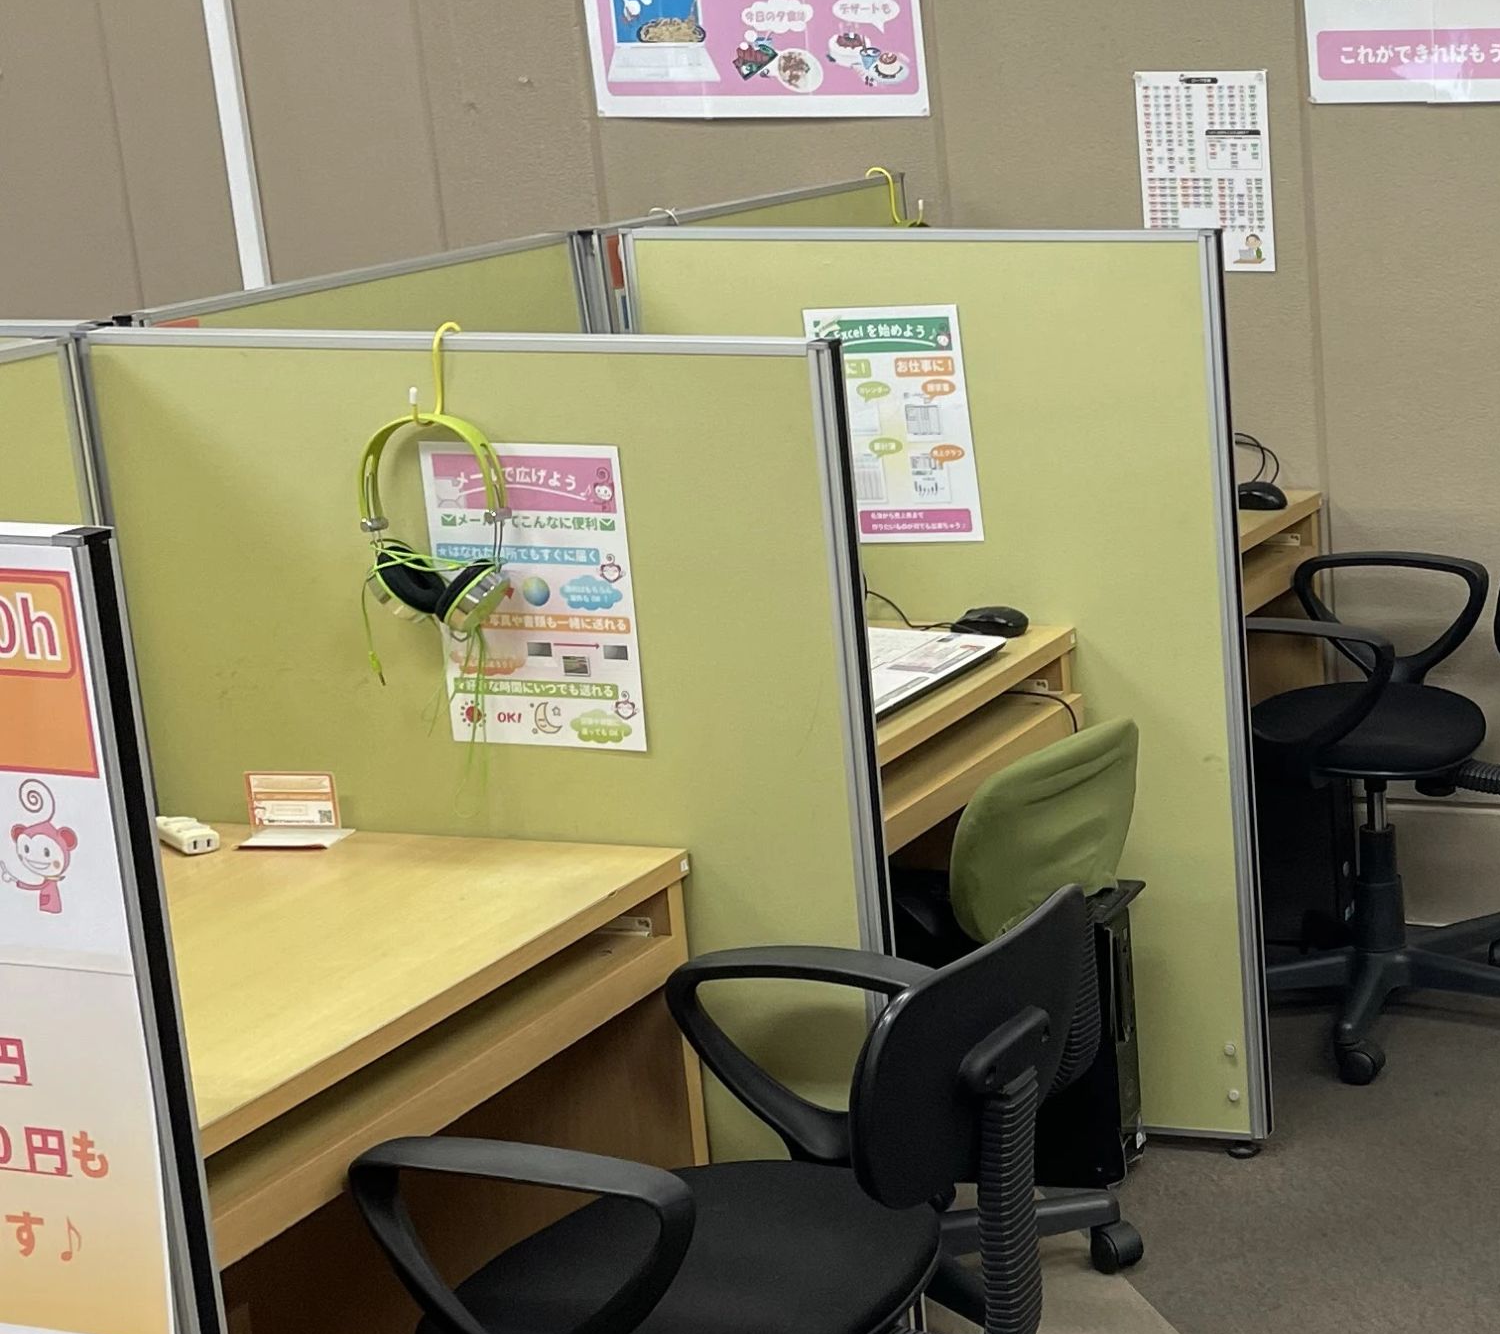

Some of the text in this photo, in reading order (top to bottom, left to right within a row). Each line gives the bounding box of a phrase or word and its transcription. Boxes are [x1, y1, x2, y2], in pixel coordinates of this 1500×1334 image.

[839, 3, 892, 15] デザートも
[868, 323, 926, 338] を始めよう
[896, 359, 953, 373] お仕事に!
[458, 515, 598, 531] メーてこんなに便利
[496, 712, 522, 723] OK!
